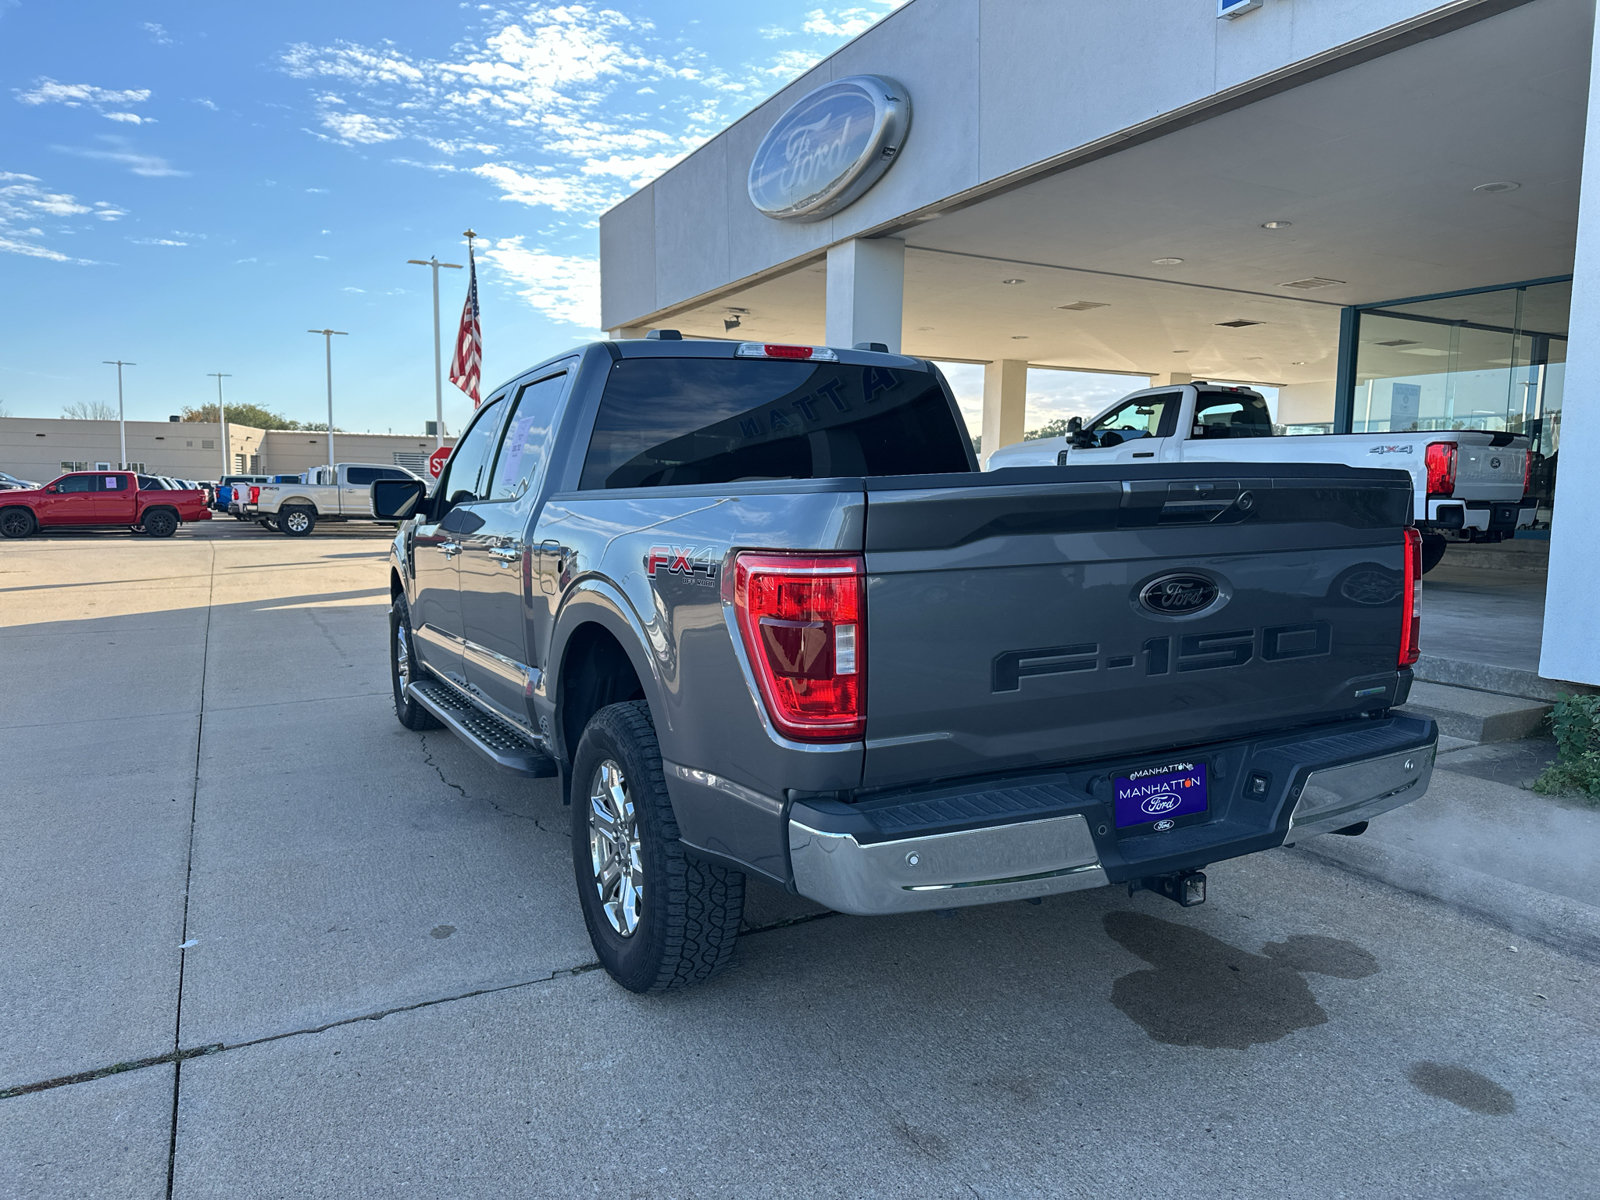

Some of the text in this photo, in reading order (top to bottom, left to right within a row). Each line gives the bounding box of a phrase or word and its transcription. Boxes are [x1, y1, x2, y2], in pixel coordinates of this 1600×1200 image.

[780, 111, 852, 193] Ford
[432, 458, 448, 473] ST
[647, 543, 718, 580] FX4
[1162, 583, 1203, 607] Ford
[991, 620, 1333, 694] F-150
[1148, 796, 1175, 812] Ford
[1157, 820, 1171, 830] Ford
